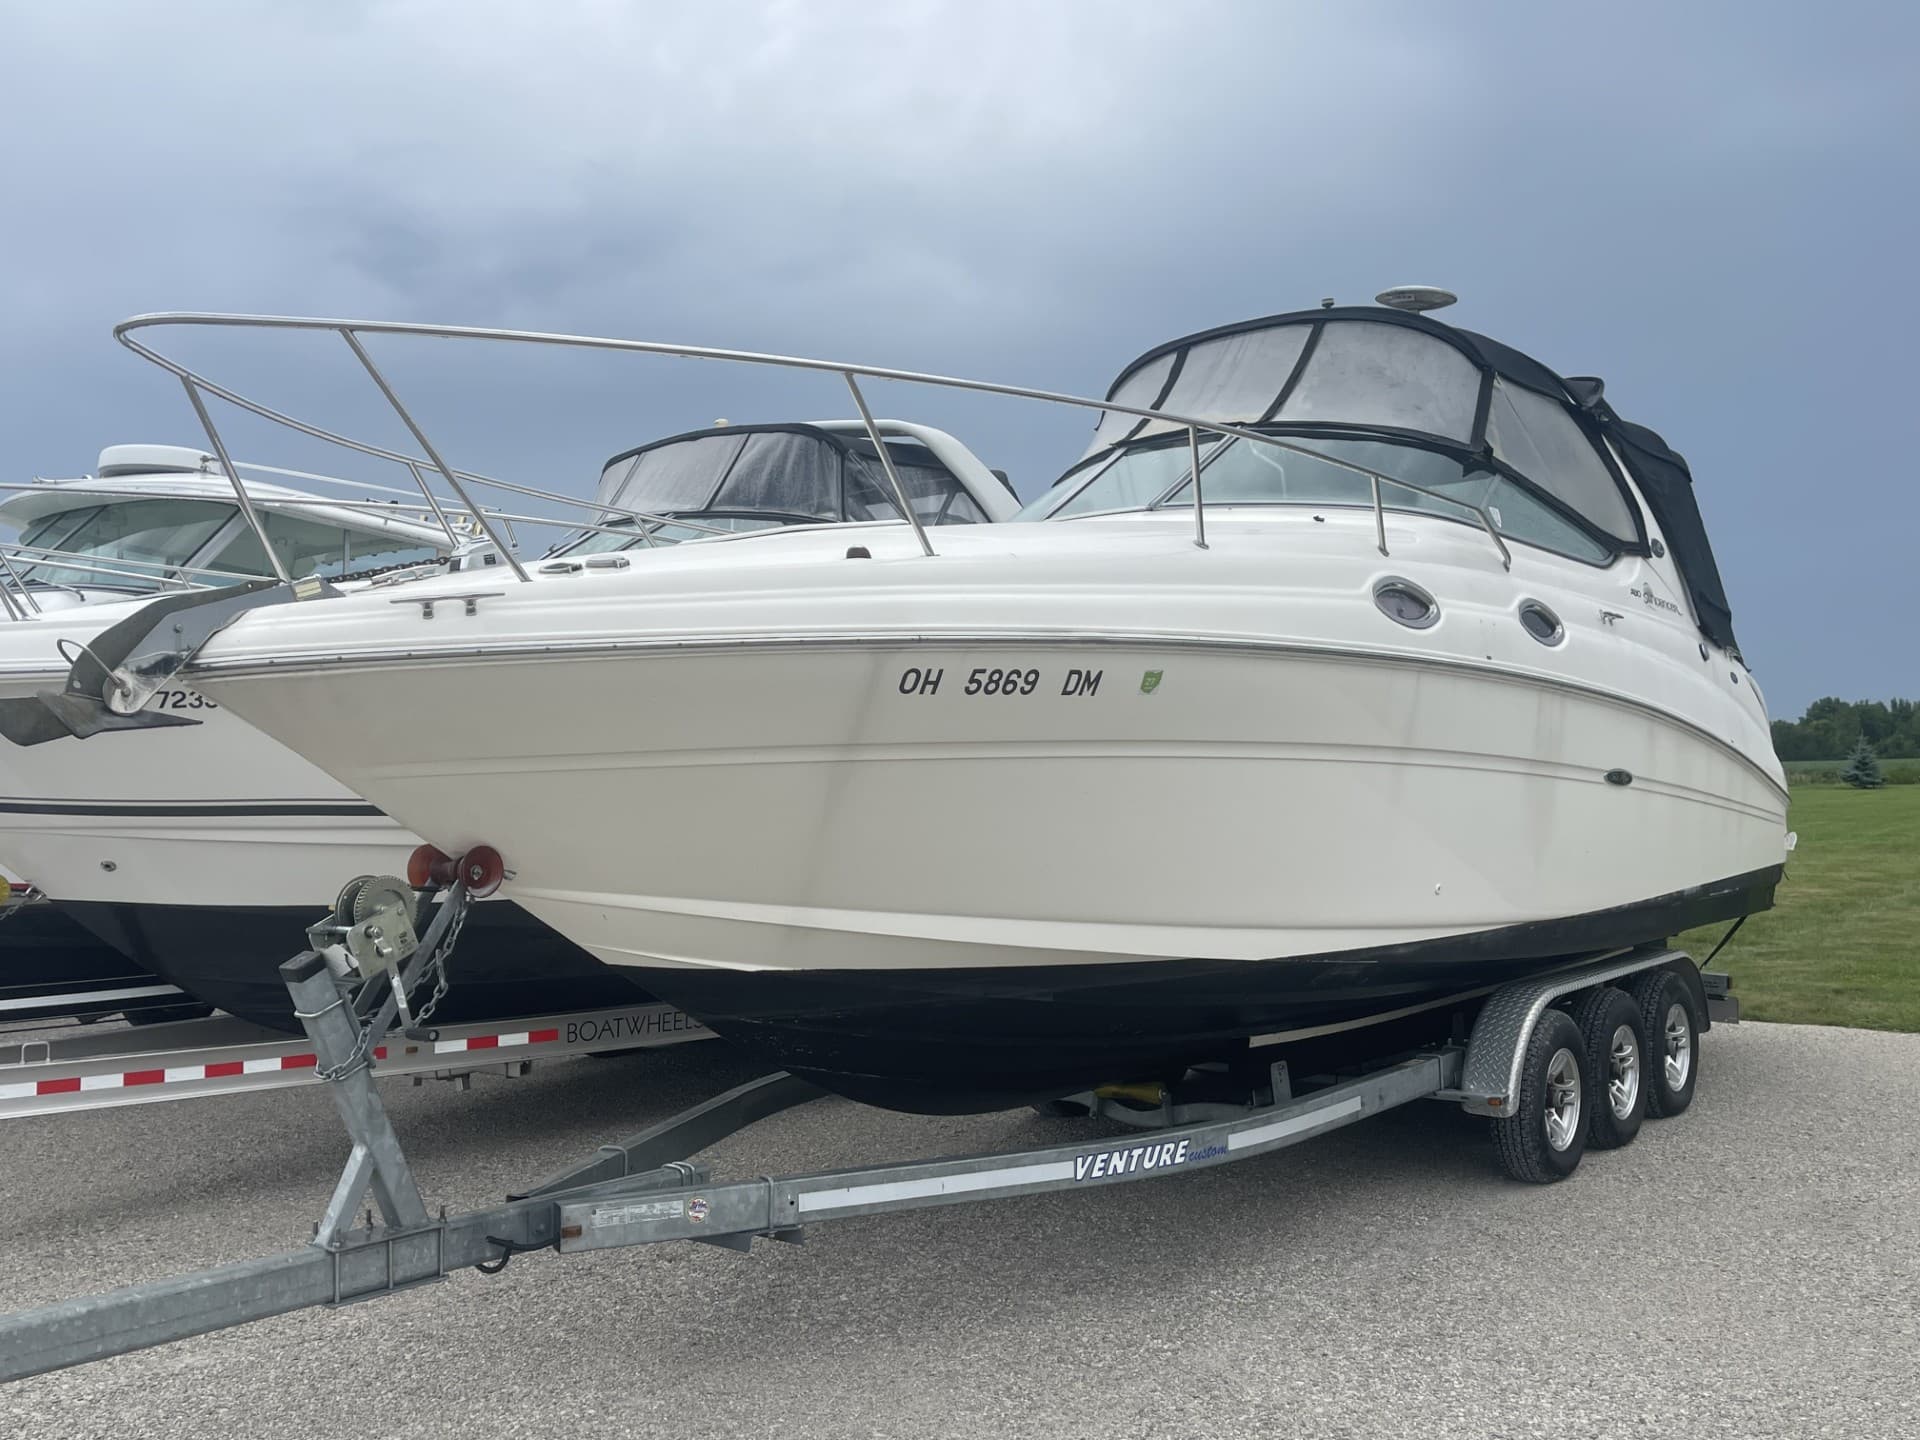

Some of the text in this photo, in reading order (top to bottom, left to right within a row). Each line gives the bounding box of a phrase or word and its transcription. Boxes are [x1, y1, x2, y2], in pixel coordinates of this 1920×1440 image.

[899, 668, 1103, 697] OH 5869 DM
[1074, 1137, 1228, 1181] VENTURE custom
